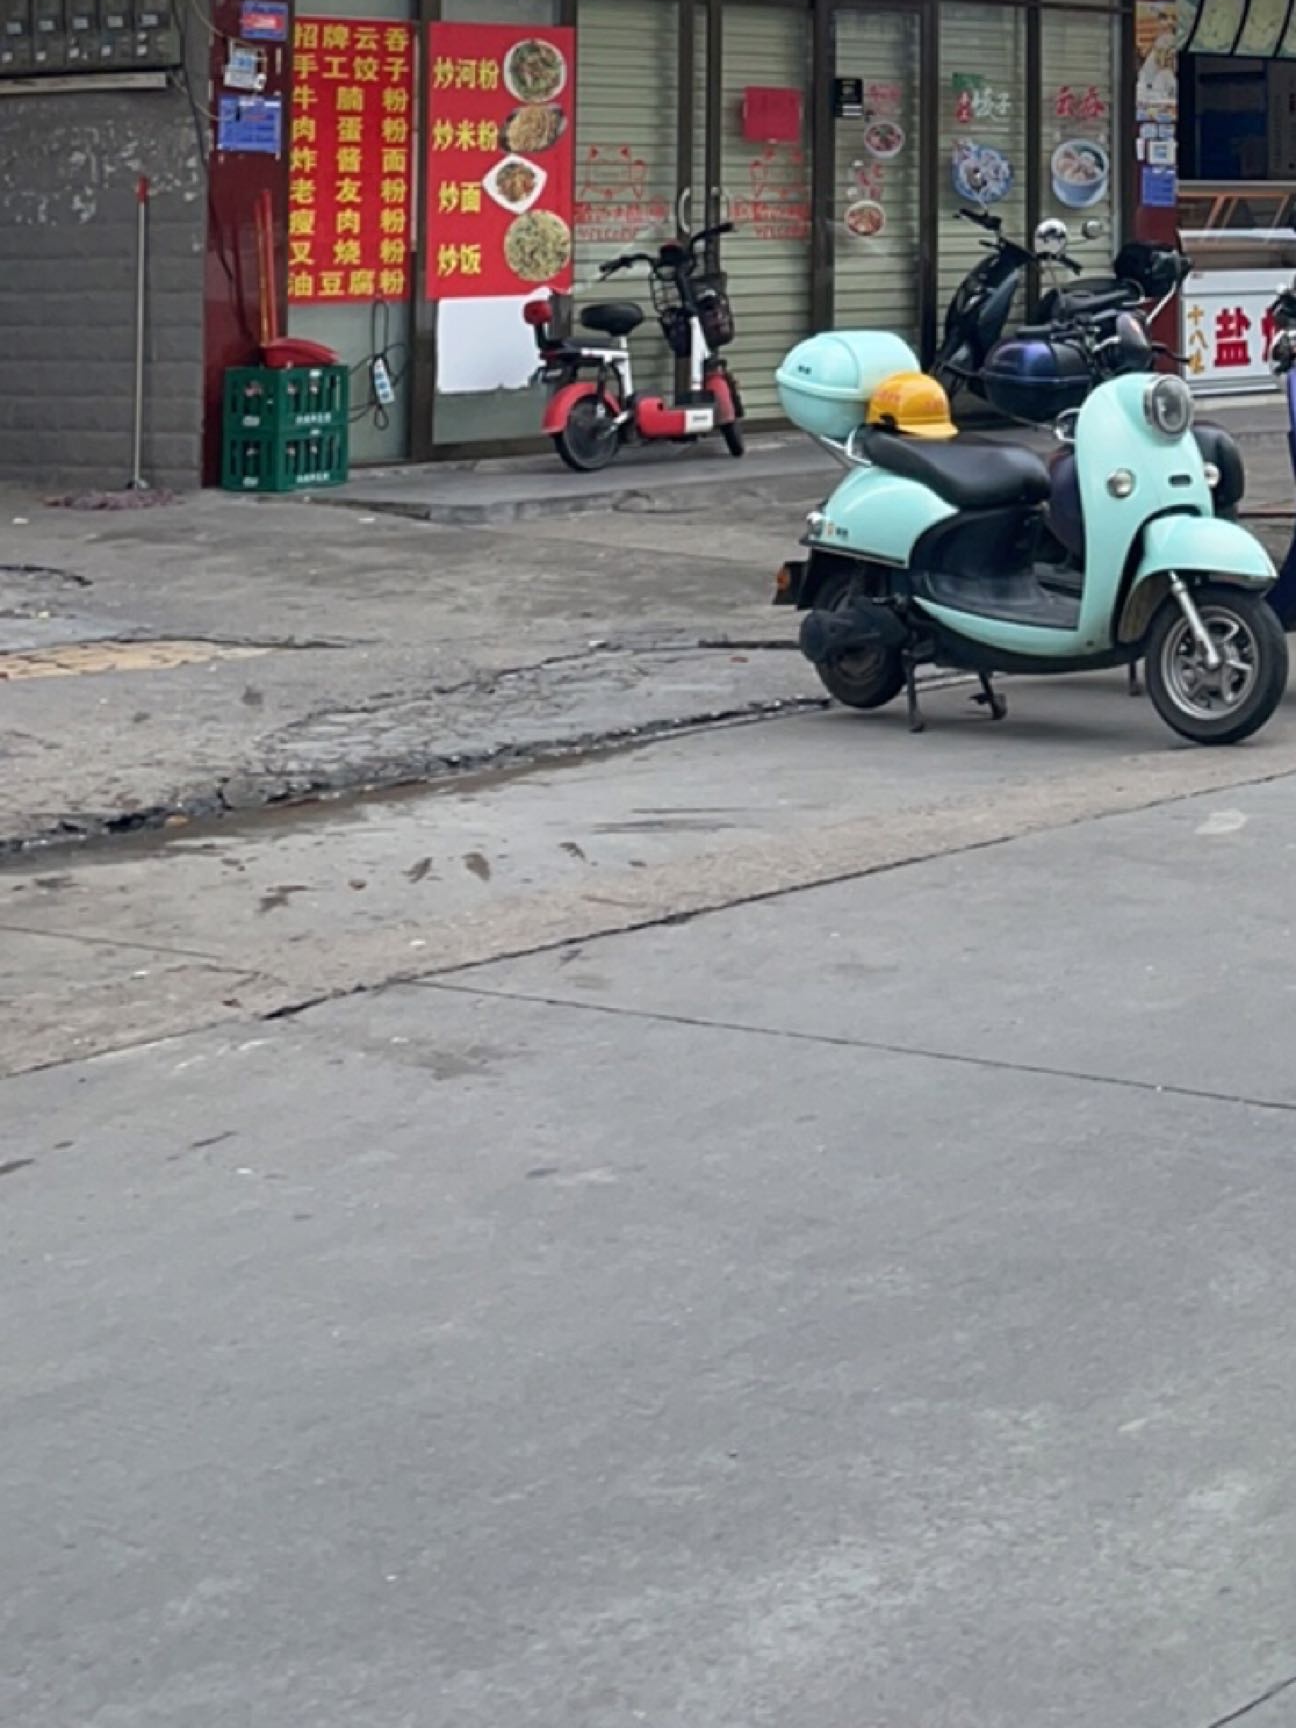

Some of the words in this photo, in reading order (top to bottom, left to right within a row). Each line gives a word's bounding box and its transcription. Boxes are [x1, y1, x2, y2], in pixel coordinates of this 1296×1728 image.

[293, 22, 409, 52] 招牌云吞
[292, 53, 409, 82] 手工饺子
[433, 56, 499, 90] 炒河粉
[432, 118, 499, 151] 炒米粉
[438, 180, 481, 214] 炒面
[437, 243, 481, 276] 炒饭
